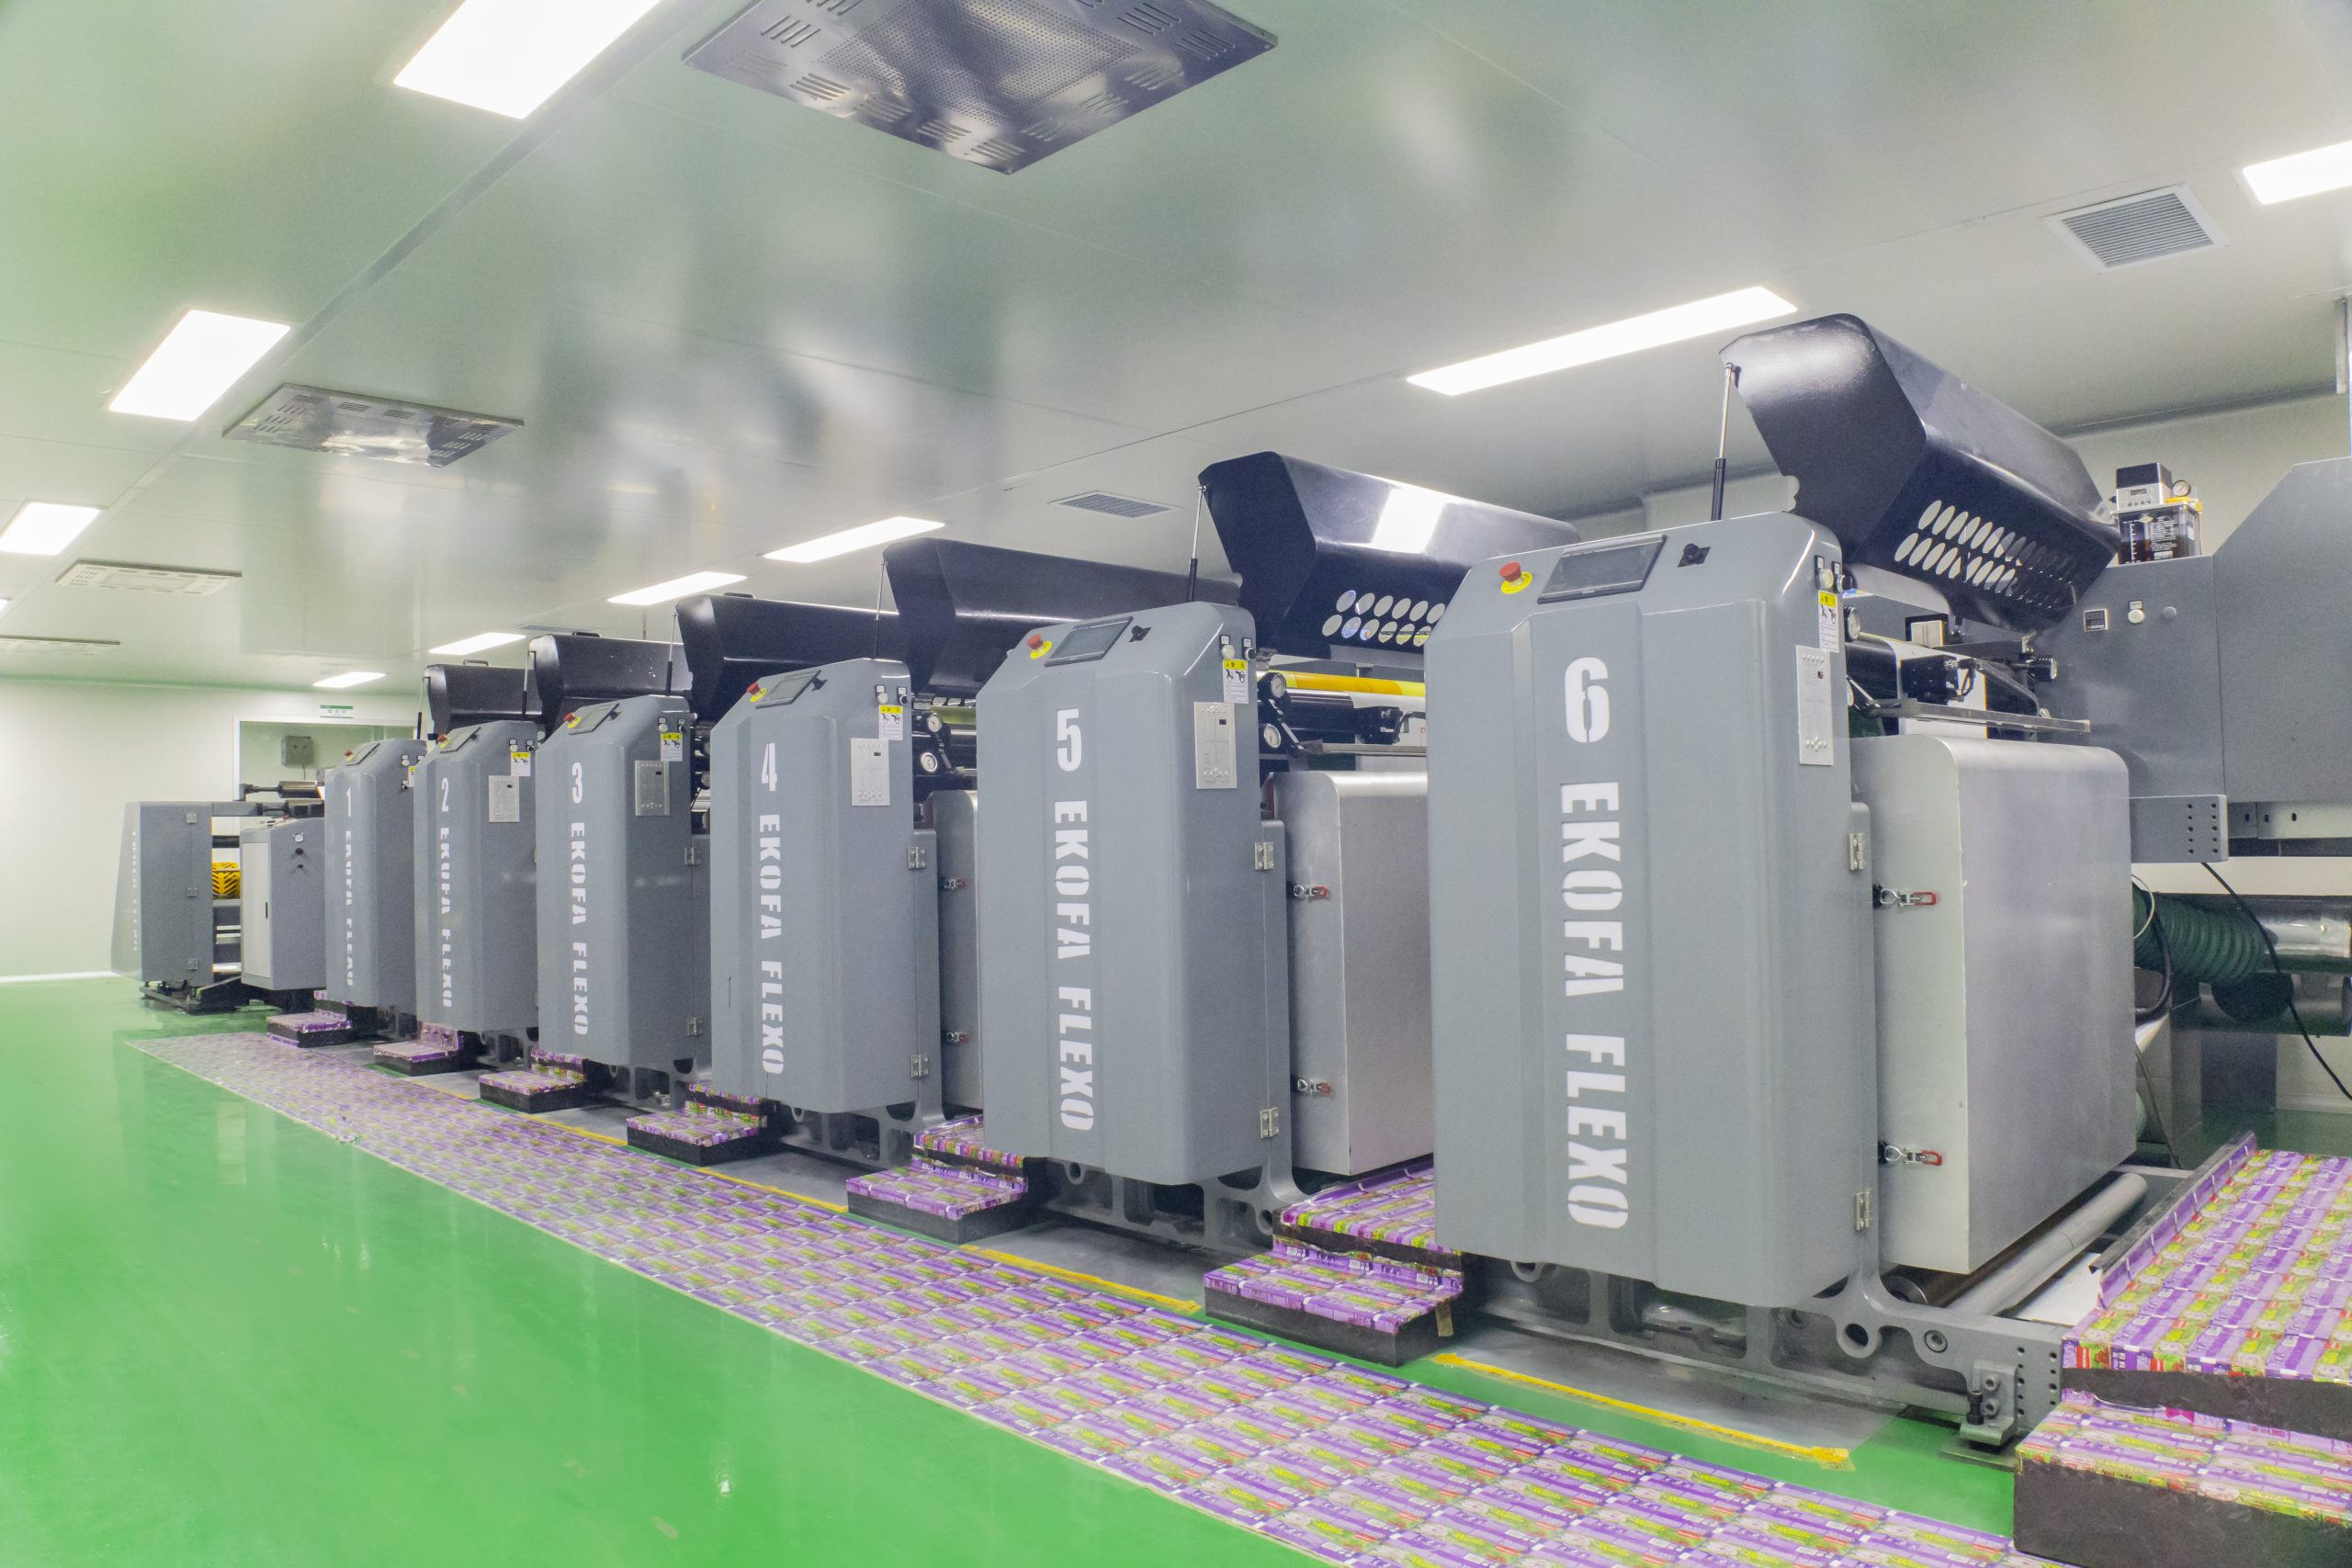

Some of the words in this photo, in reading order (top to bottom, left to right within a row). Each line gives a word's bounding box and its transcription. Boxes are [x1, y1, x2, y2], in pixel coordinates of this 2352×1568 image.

[1057, 708, 1082, 772] 5
[1564, 657, 1610, 743] 6
[345, 787, 352, 818] 1
[441, 777, 449, 812] 2
[571, 761, 583, 804] 3
[761, 742, 778, 792] 4
[440, 827, 450, 914] EKOFA
[571, 822, 586, 925] EKOFA
[759, 814, 782, 940] EKOFA
[1054, 800, 1091, 960] EKOFA
[1561, 782, 1624, 997] EKOFA
[441, 928, 452, 1008] FLEXO
[572, 942, 589, 1035] FLEXO
[761, 960, 784, 1075] FLEXO
[1057, 986, 1094, 1131] FLEXO
[1566, 1033, 1629, 1228] FLEXO
